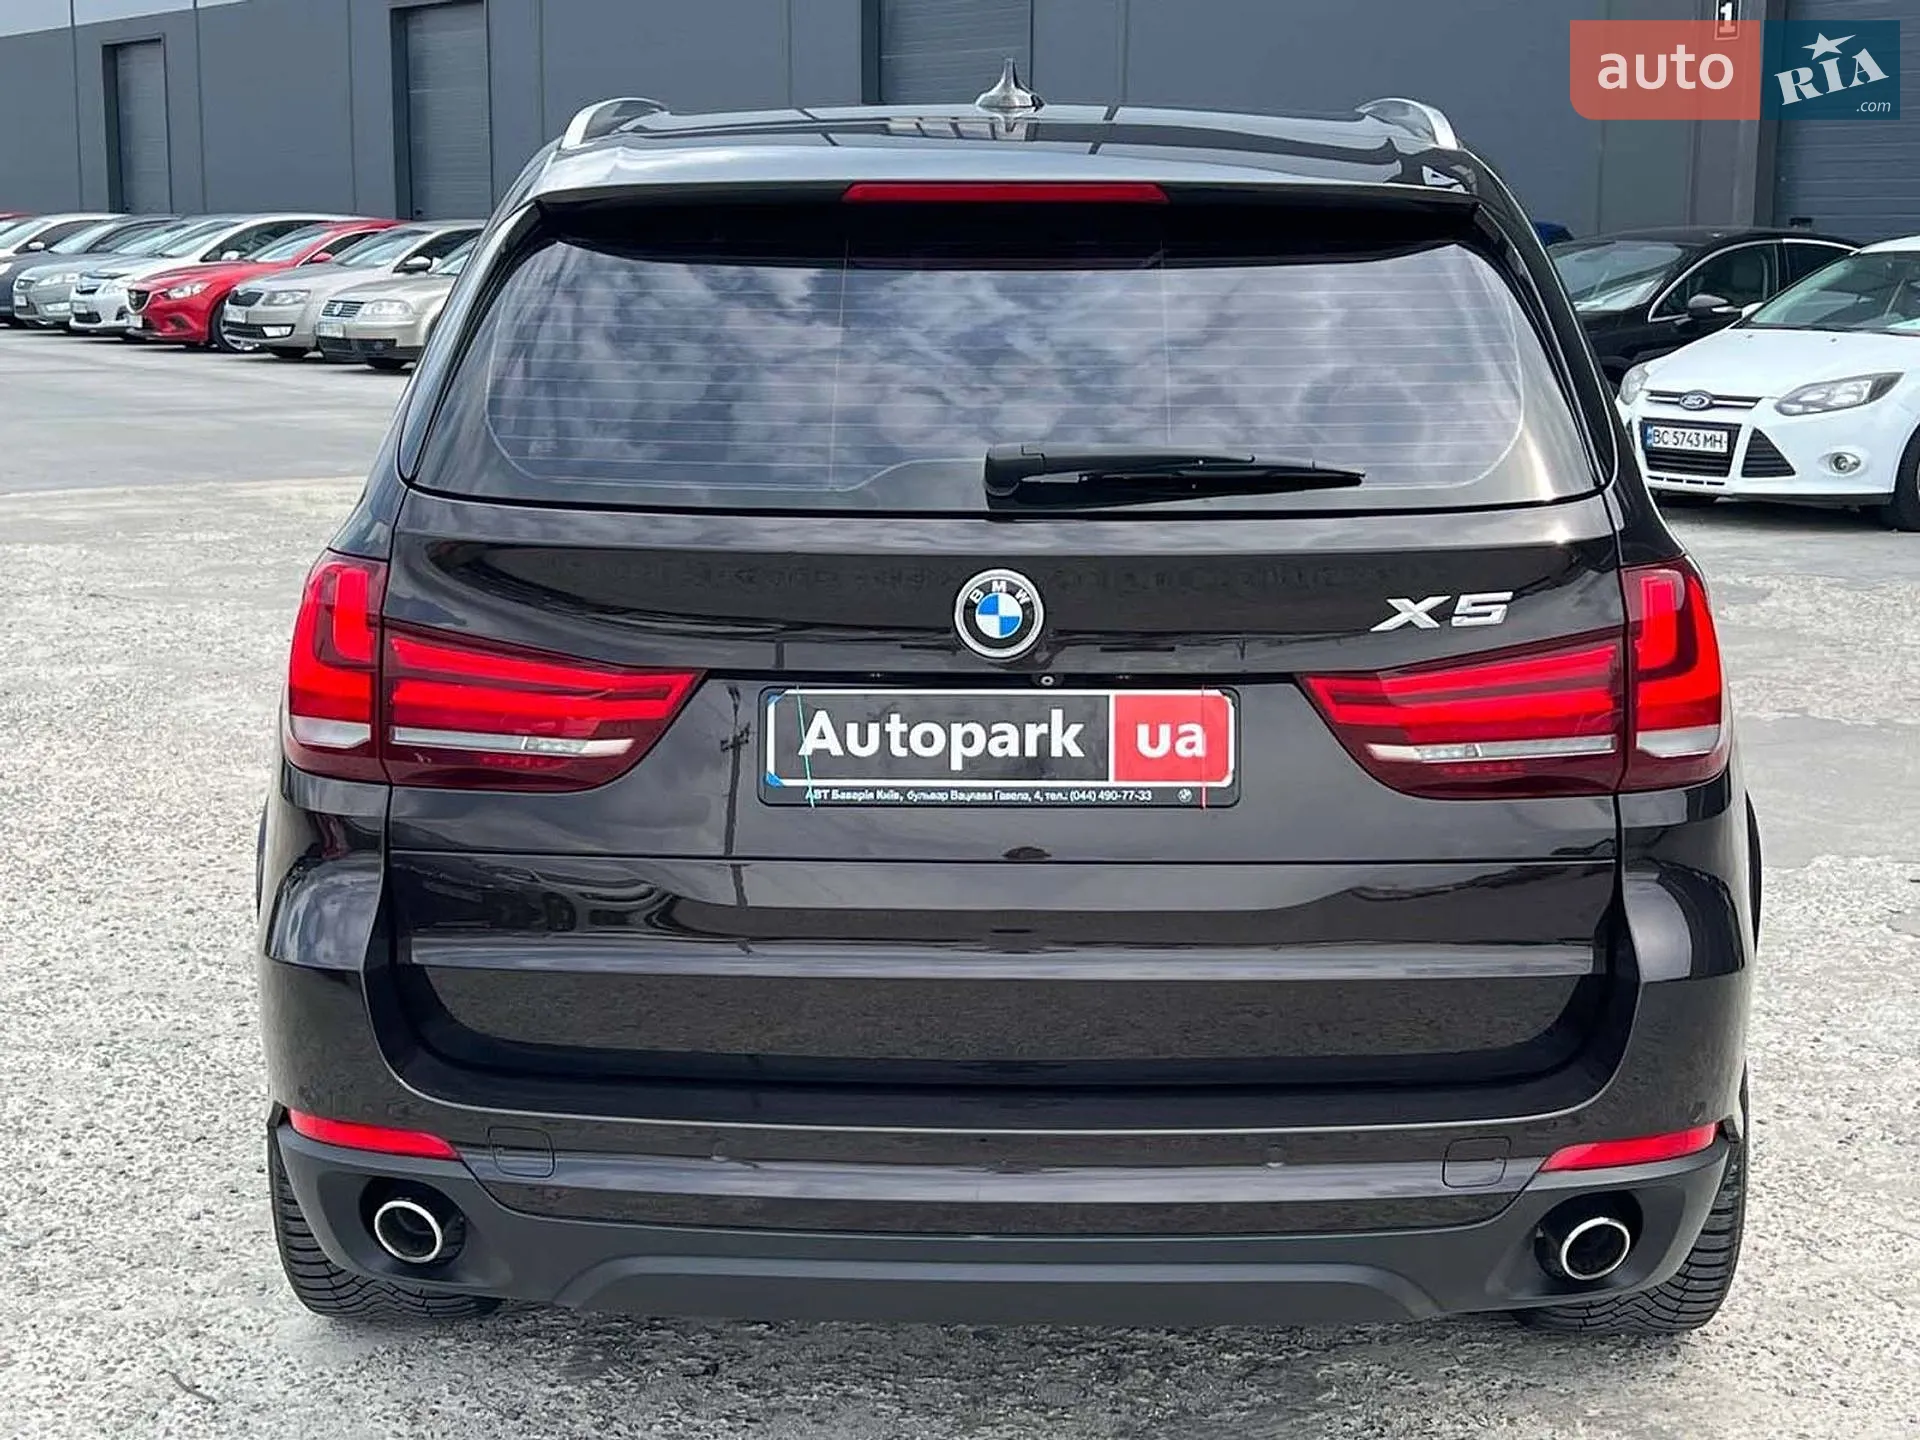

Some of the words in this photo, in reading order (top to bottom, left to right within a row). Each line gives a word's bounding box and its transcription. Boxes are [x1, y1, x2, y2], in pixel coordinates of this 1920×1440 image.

[1719, 2, 1736, 33] 1
[1652, 428, 1669, 446] BC
[1672, 430, 1701, 448] 5743
[1703, 433, 1724, 449] MH
[969, 580, 1031, 605] BMW
[1370, 591, 1514, 632] X5
[798, 709, 1085, 771] Autopark
[1135, 722, 1205, 759] ua
[1069, 789, 1096, 802] (044)
[1098, 789, 1153, 801] 490-77-33
